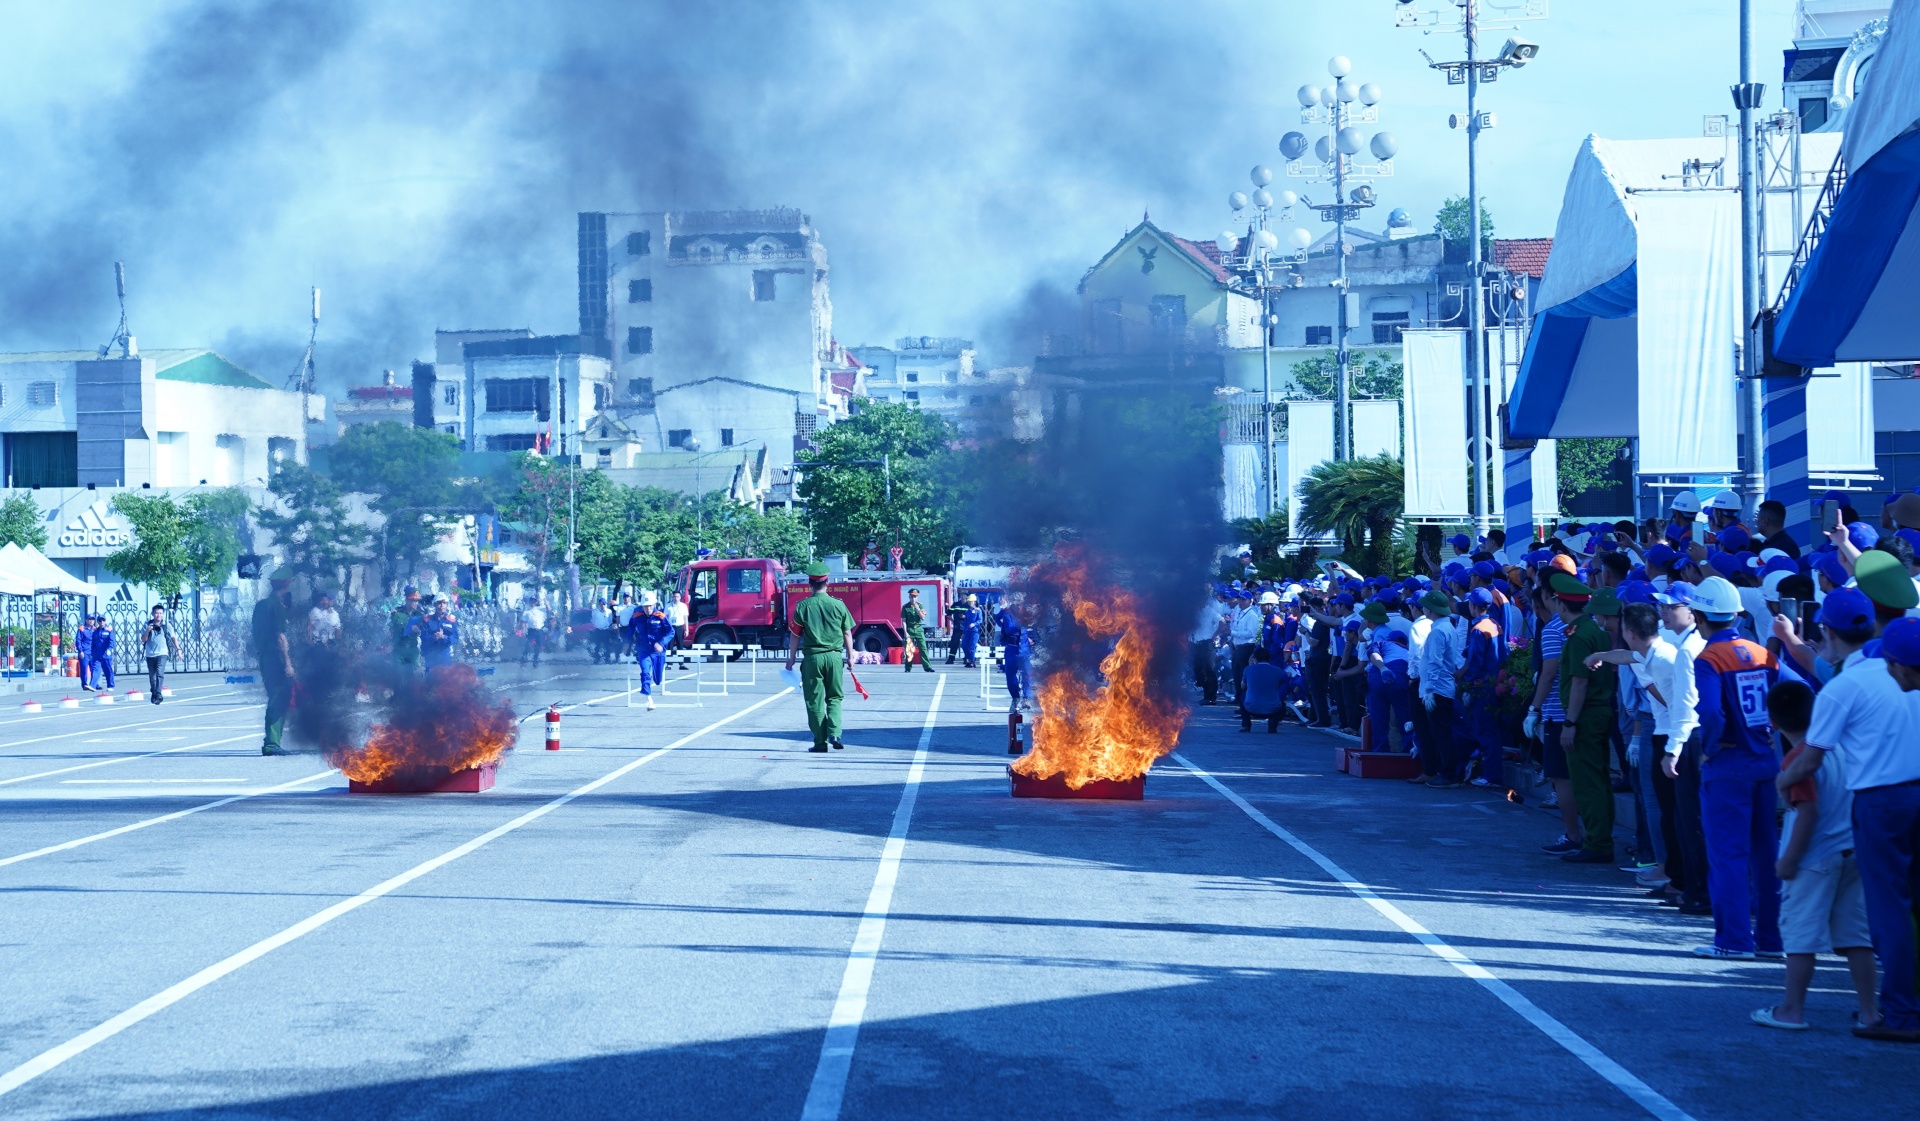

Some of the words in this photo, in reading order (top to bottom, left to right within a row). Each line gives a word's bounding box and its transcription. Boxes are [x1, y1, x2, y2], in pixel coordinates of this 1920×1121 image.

[61, 528, 130, 546] adidas
[105, 601, 138, 612] adidas
[1741, 683, 1768, 714] 51
